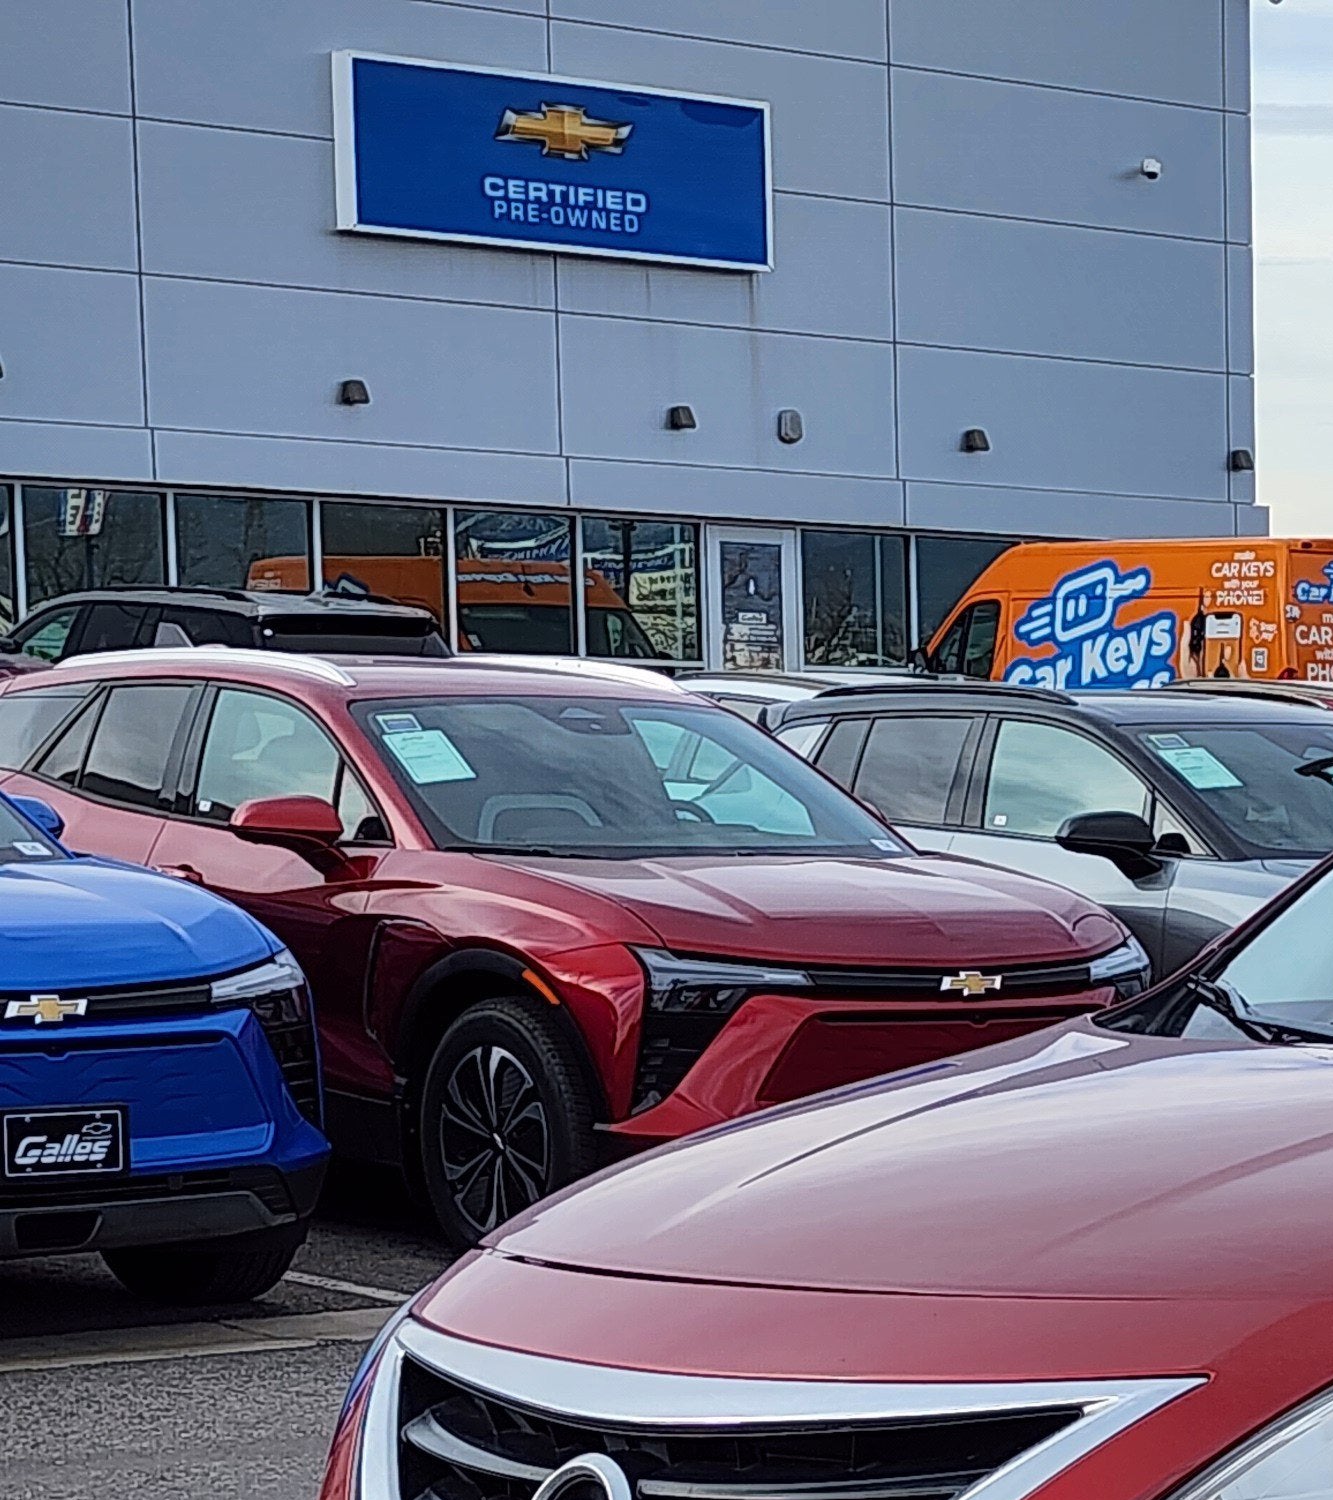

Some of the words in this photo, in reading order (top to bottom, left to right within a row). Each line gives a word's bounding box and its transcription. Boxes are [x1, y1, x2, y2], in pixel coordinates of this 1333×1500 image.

[483, 176, 647, 213] CERTIFIED
[493, 200, 639, 233] PRE-OWNED
[1211, 562, 1239, 578] CAR
[1241, 561, 1275, 578] KEYS
[1296, 582, 1328, 601] Car
[1295, 625, 1333, 646] CAR
[1081, 619, 1173, 686] Keys
[14, 1133, 112, 1165] Galles
